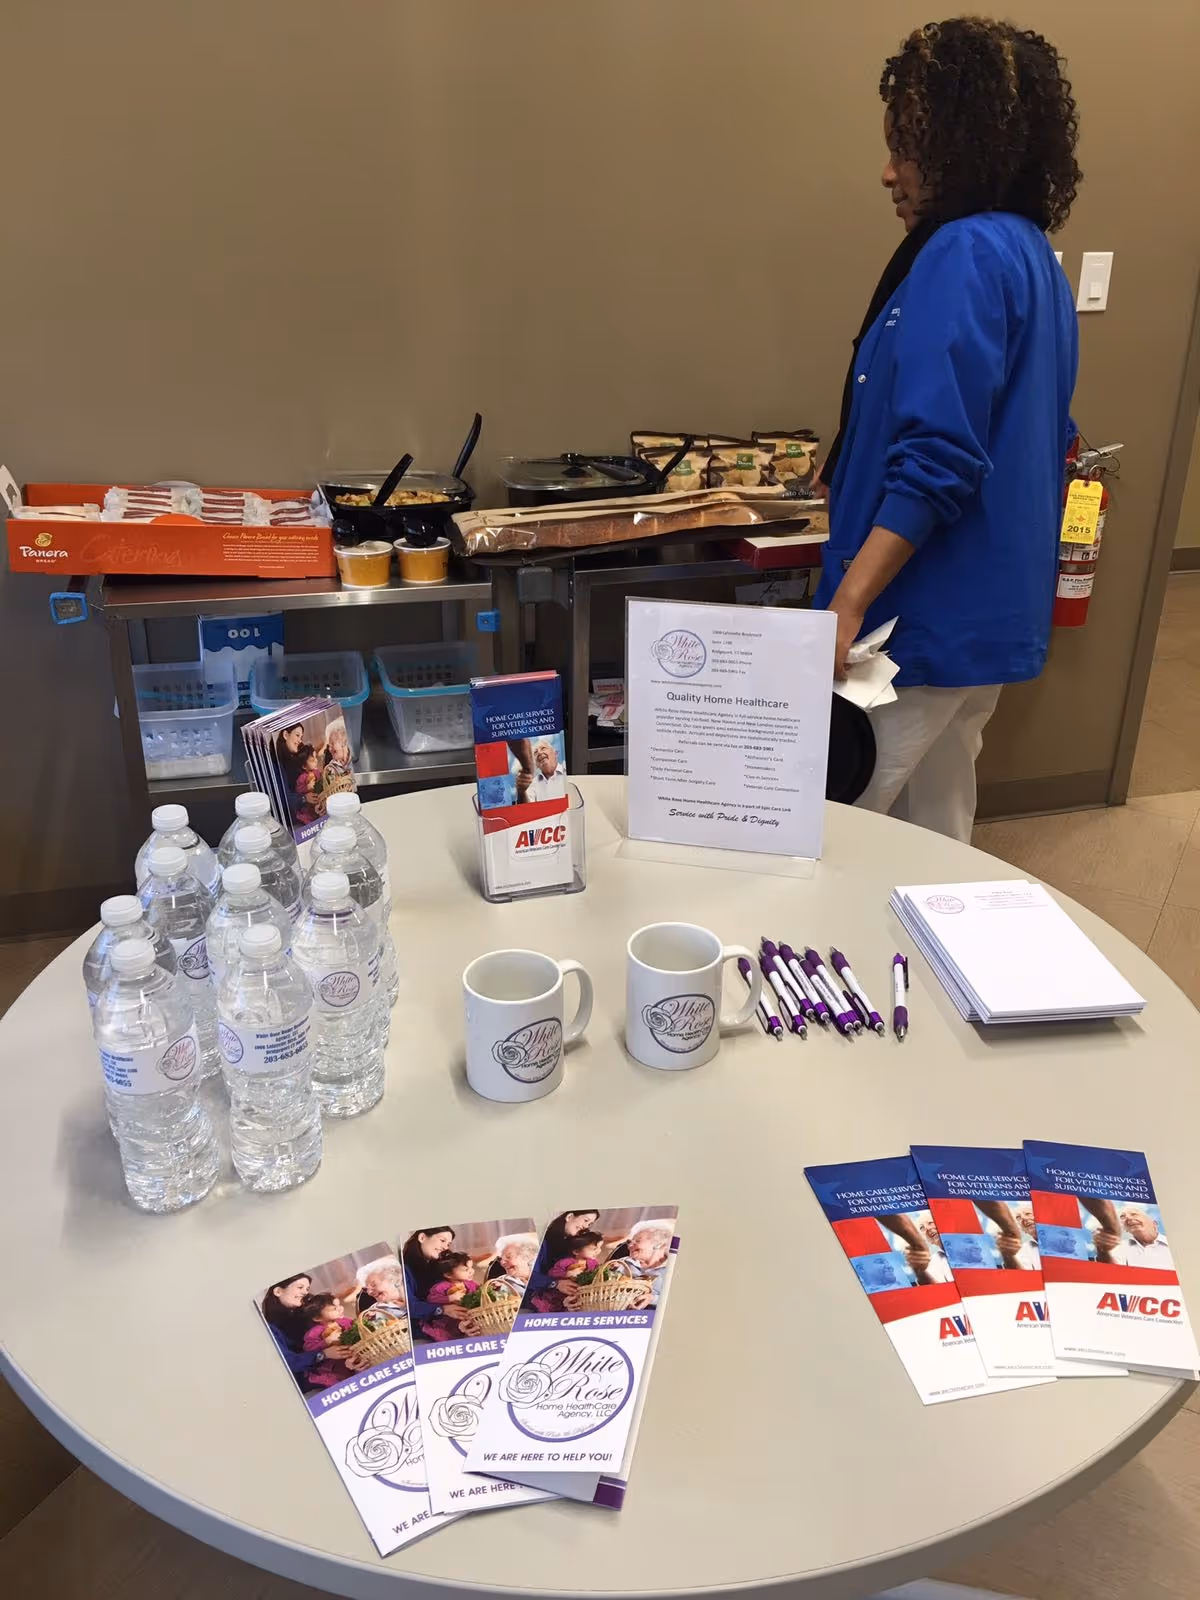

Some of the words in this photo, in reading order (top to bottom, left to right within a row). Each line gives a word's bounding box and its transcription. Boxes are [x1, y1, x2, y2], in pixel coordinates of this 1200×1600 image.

[1067, 525, 1091, 534] 2015
[18, 546, 69, 559] Panera
[670, 634, 701, 649] White
[666, 691, 702, 704] Quality
[703, 695, 733, 705] Home
[735, 697, 789, 709] Healthcare
[485, 715, 507, 724] HOME
[507, 711, 525, 720] CARE
[525, 708, 555, 718] SERVICES
[491, 723, 506, 731] FOR
[505, 719, 539, 729] VETERANS
[491, 727, 528, 739] SURVIVING
[528, 724, 556, 733] SPOUSES
[668, 808, 696, 817] Service
[698, 811, 714, 819] with
[717, 812, 739, 822] Pride
[749, 816, 780, 827] Dignity
[301, 824, 320, 839] HOME
[937, 1172, 967, 1181] HOME
[967, 1173, 991, 1182] CARE
[1046, 1167, 1076, 1177] HOME
[1077, 1171, 1101, 1181] CARE
[1104, 1174, 1147, 1185] SERVICES
[967, 1181, 1013, 1190] VETERANS
[1055, 1175, 1075, 1184] FOR
[1075, 1178, 1124, 1190] VETERANS
[1124, 1184, 1148, 1193] AND
[1055, 1182, 1108, 1196] SURVIVING
[1109, 1189, 1150, 1200] SPOUSES
[836, 1190, 866, 1200] HOME
[866, 1187, 890, 1197] CARE
[847, 1198, 867, 1206] FOR
[866, 1194, 911, 1204] VETERANS
[948, 1188, 1000, 1197] SURVIVING
[849, 1202, 900, 1214] SURVIVING
[1096, 1292, 1181, 1318] AVCC
[524, 1318, 559, 1328] HOME
[560, 1316, 591, 1327] CARE
[592, 1315, 648, 1325] SERVICES
[1096, 1310, 1120, 1318] American
[1121, 1312, 1143, 1321] Veterans
[426, 1344, 464, 1359] HOME
[465, 1340, 498, 1353] CARE
[500, 1339, 507, 1349] S
[942, 1339, 964, 1348] American
[540, 1341, 624, 1374] White
[321, 1382, 360, 1407] HOME
[360, 1367, 393, 1387] CARE
[544, 1371, 624, 1402] Rose
[536, 1402, 563, 1411] Home
[565, 1402, 617, 1411] HealthCare
[557, 1409, 593, 1419] Agency,
[595, 1409, 612, 1418] LLC
[483, 1453, 498, 1461] WE
[499, 1453, 518, 1461] ARE
[520, 1453, 544, 1461] HERE
[547, 1453, 561, 1461] TO
[562, 1453, 586, 1461] HELP
[589, 1453, 612, 1461] YOU!
[449, 1489, 465, 1499] WE
[468, 1485, 487, 1496] ARE
[490, 1482, 515, 1493] HERE
[392, 1520, 409, 1535] WE
[411, 1510, 430, 1526] ARE
